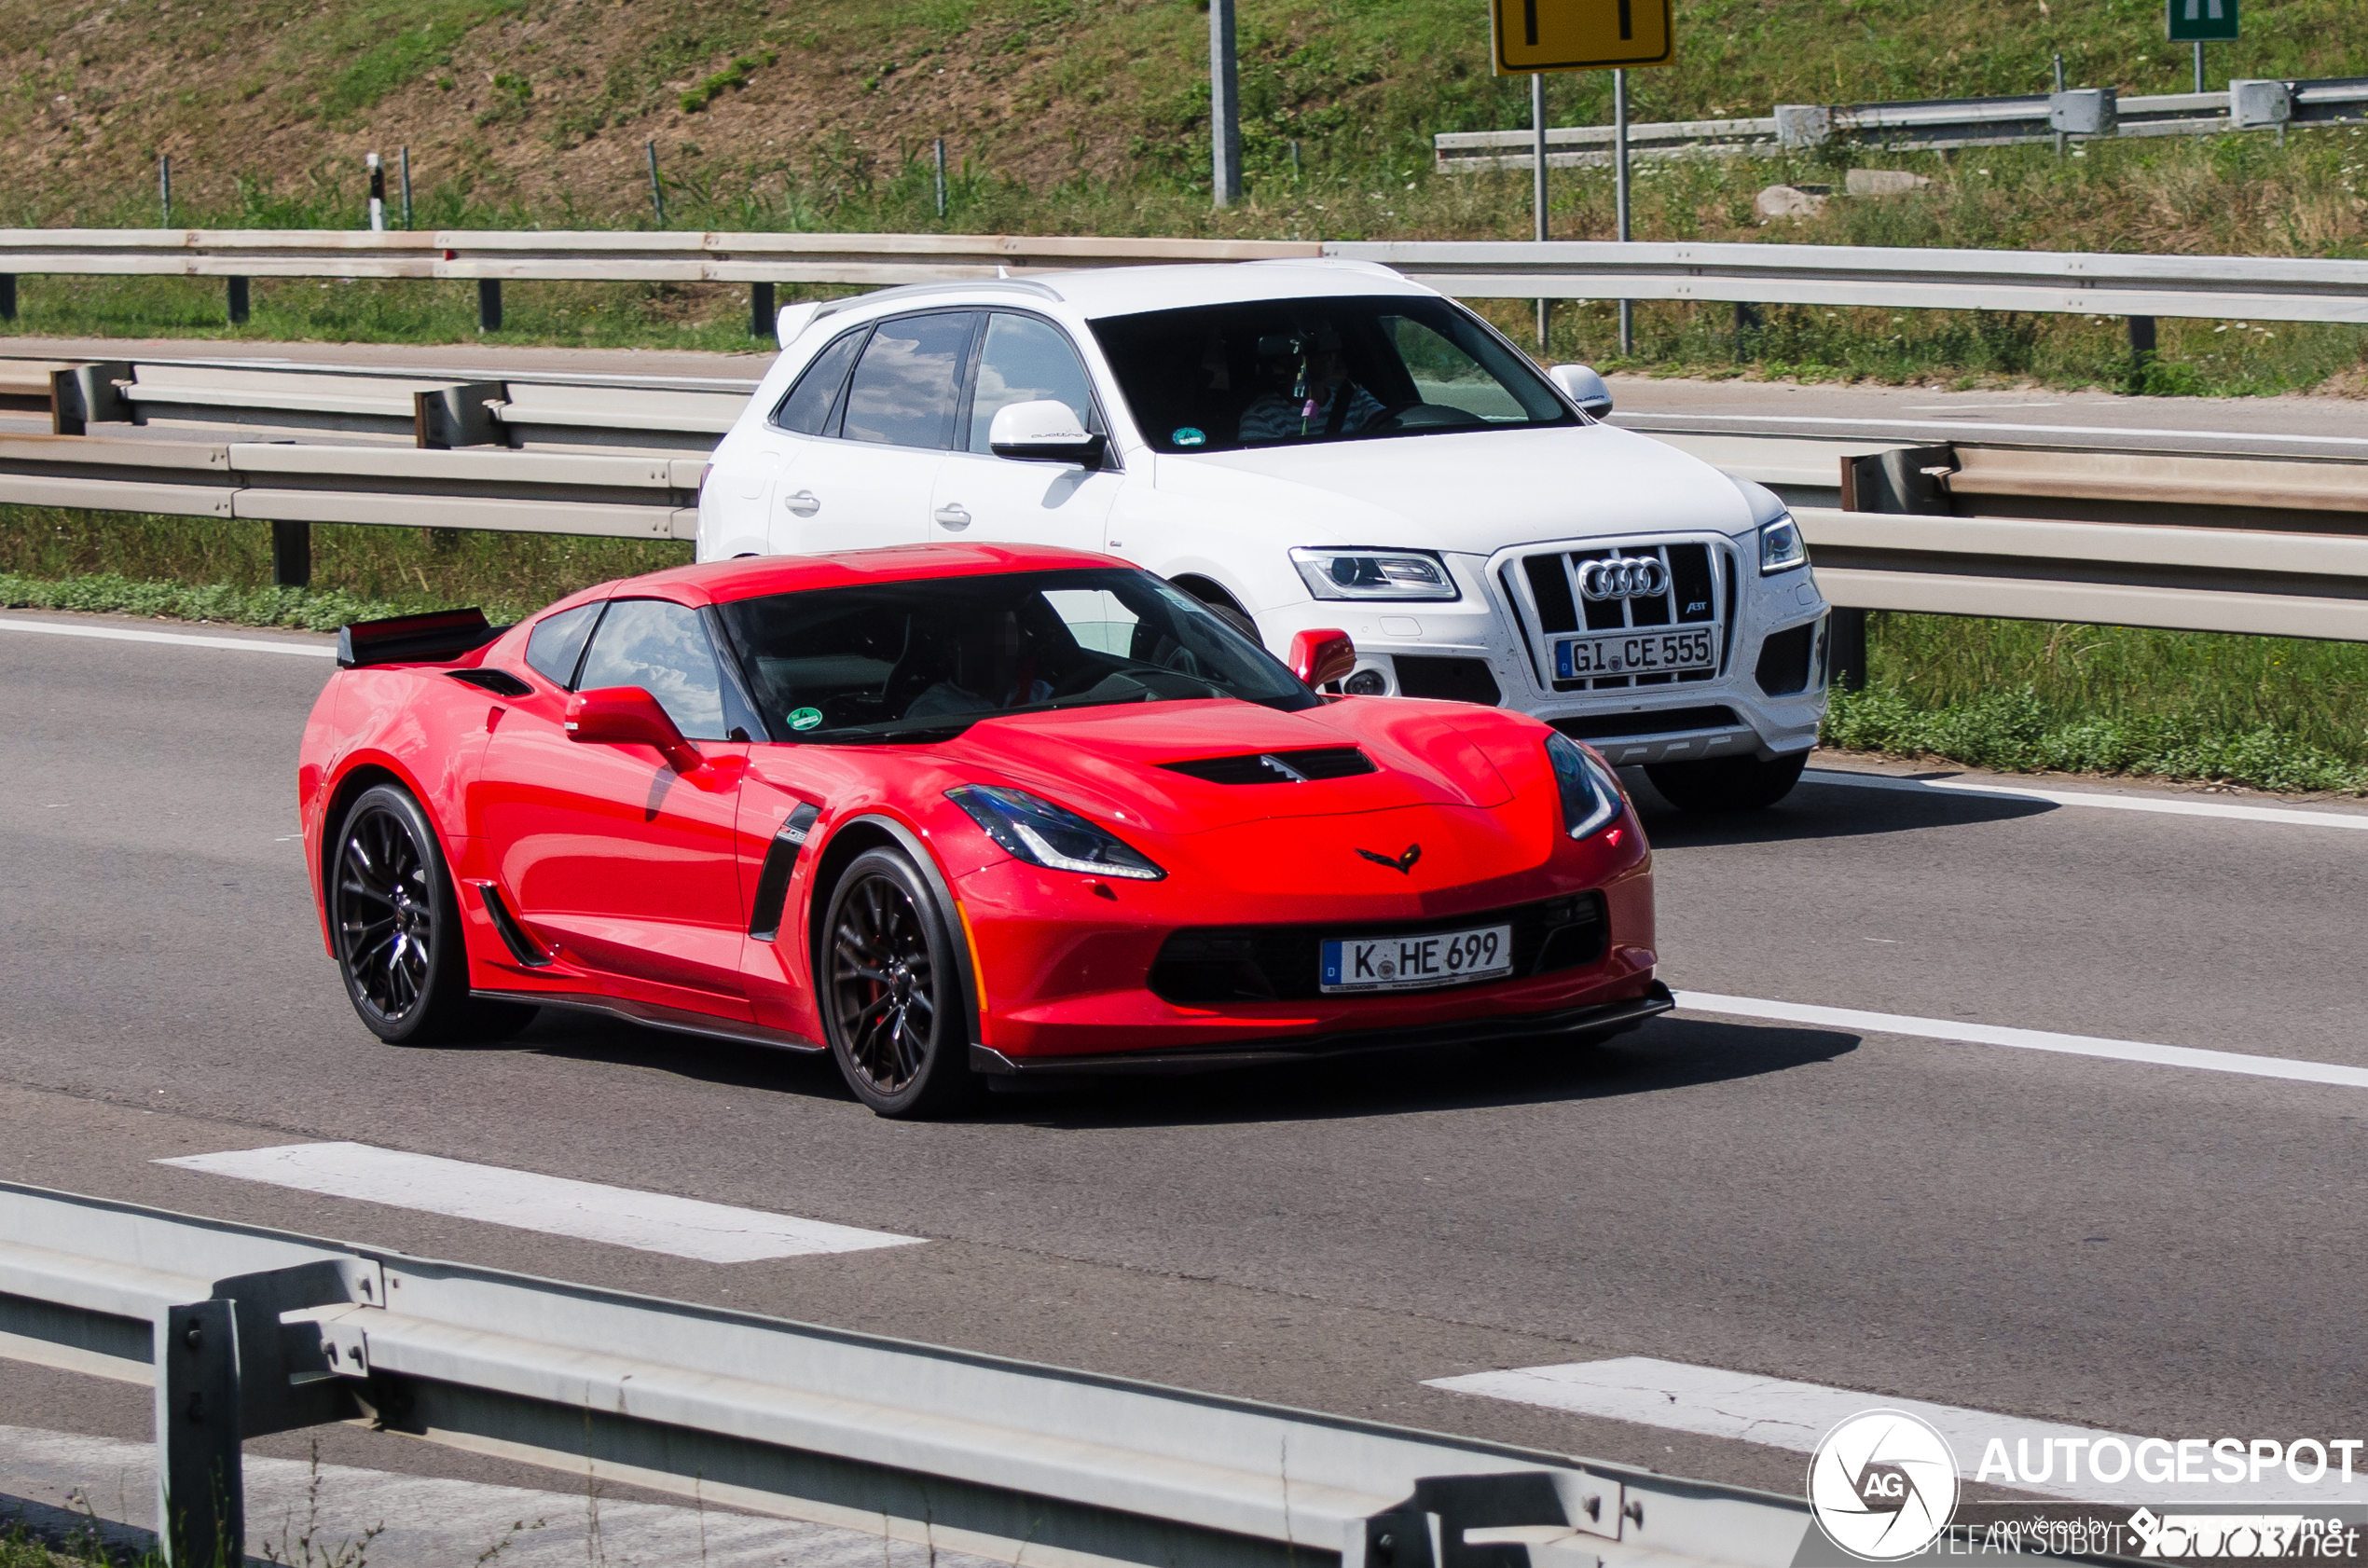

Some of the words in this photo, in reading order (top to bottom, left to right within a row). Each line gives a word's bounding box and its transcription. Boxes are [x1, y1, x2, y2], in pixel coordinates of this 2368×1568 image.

[1686, 601, 1707, 613] ABT
[1574, 642, 1605, 671] GI
[1625, 639, 1658, 667] CE
[1662, 634, 1709, 664] 555
[1355, 944, 1376, 978] K
[1399, 940, 1440, 975] HE
[1447, 932, 1499, 970] 699
